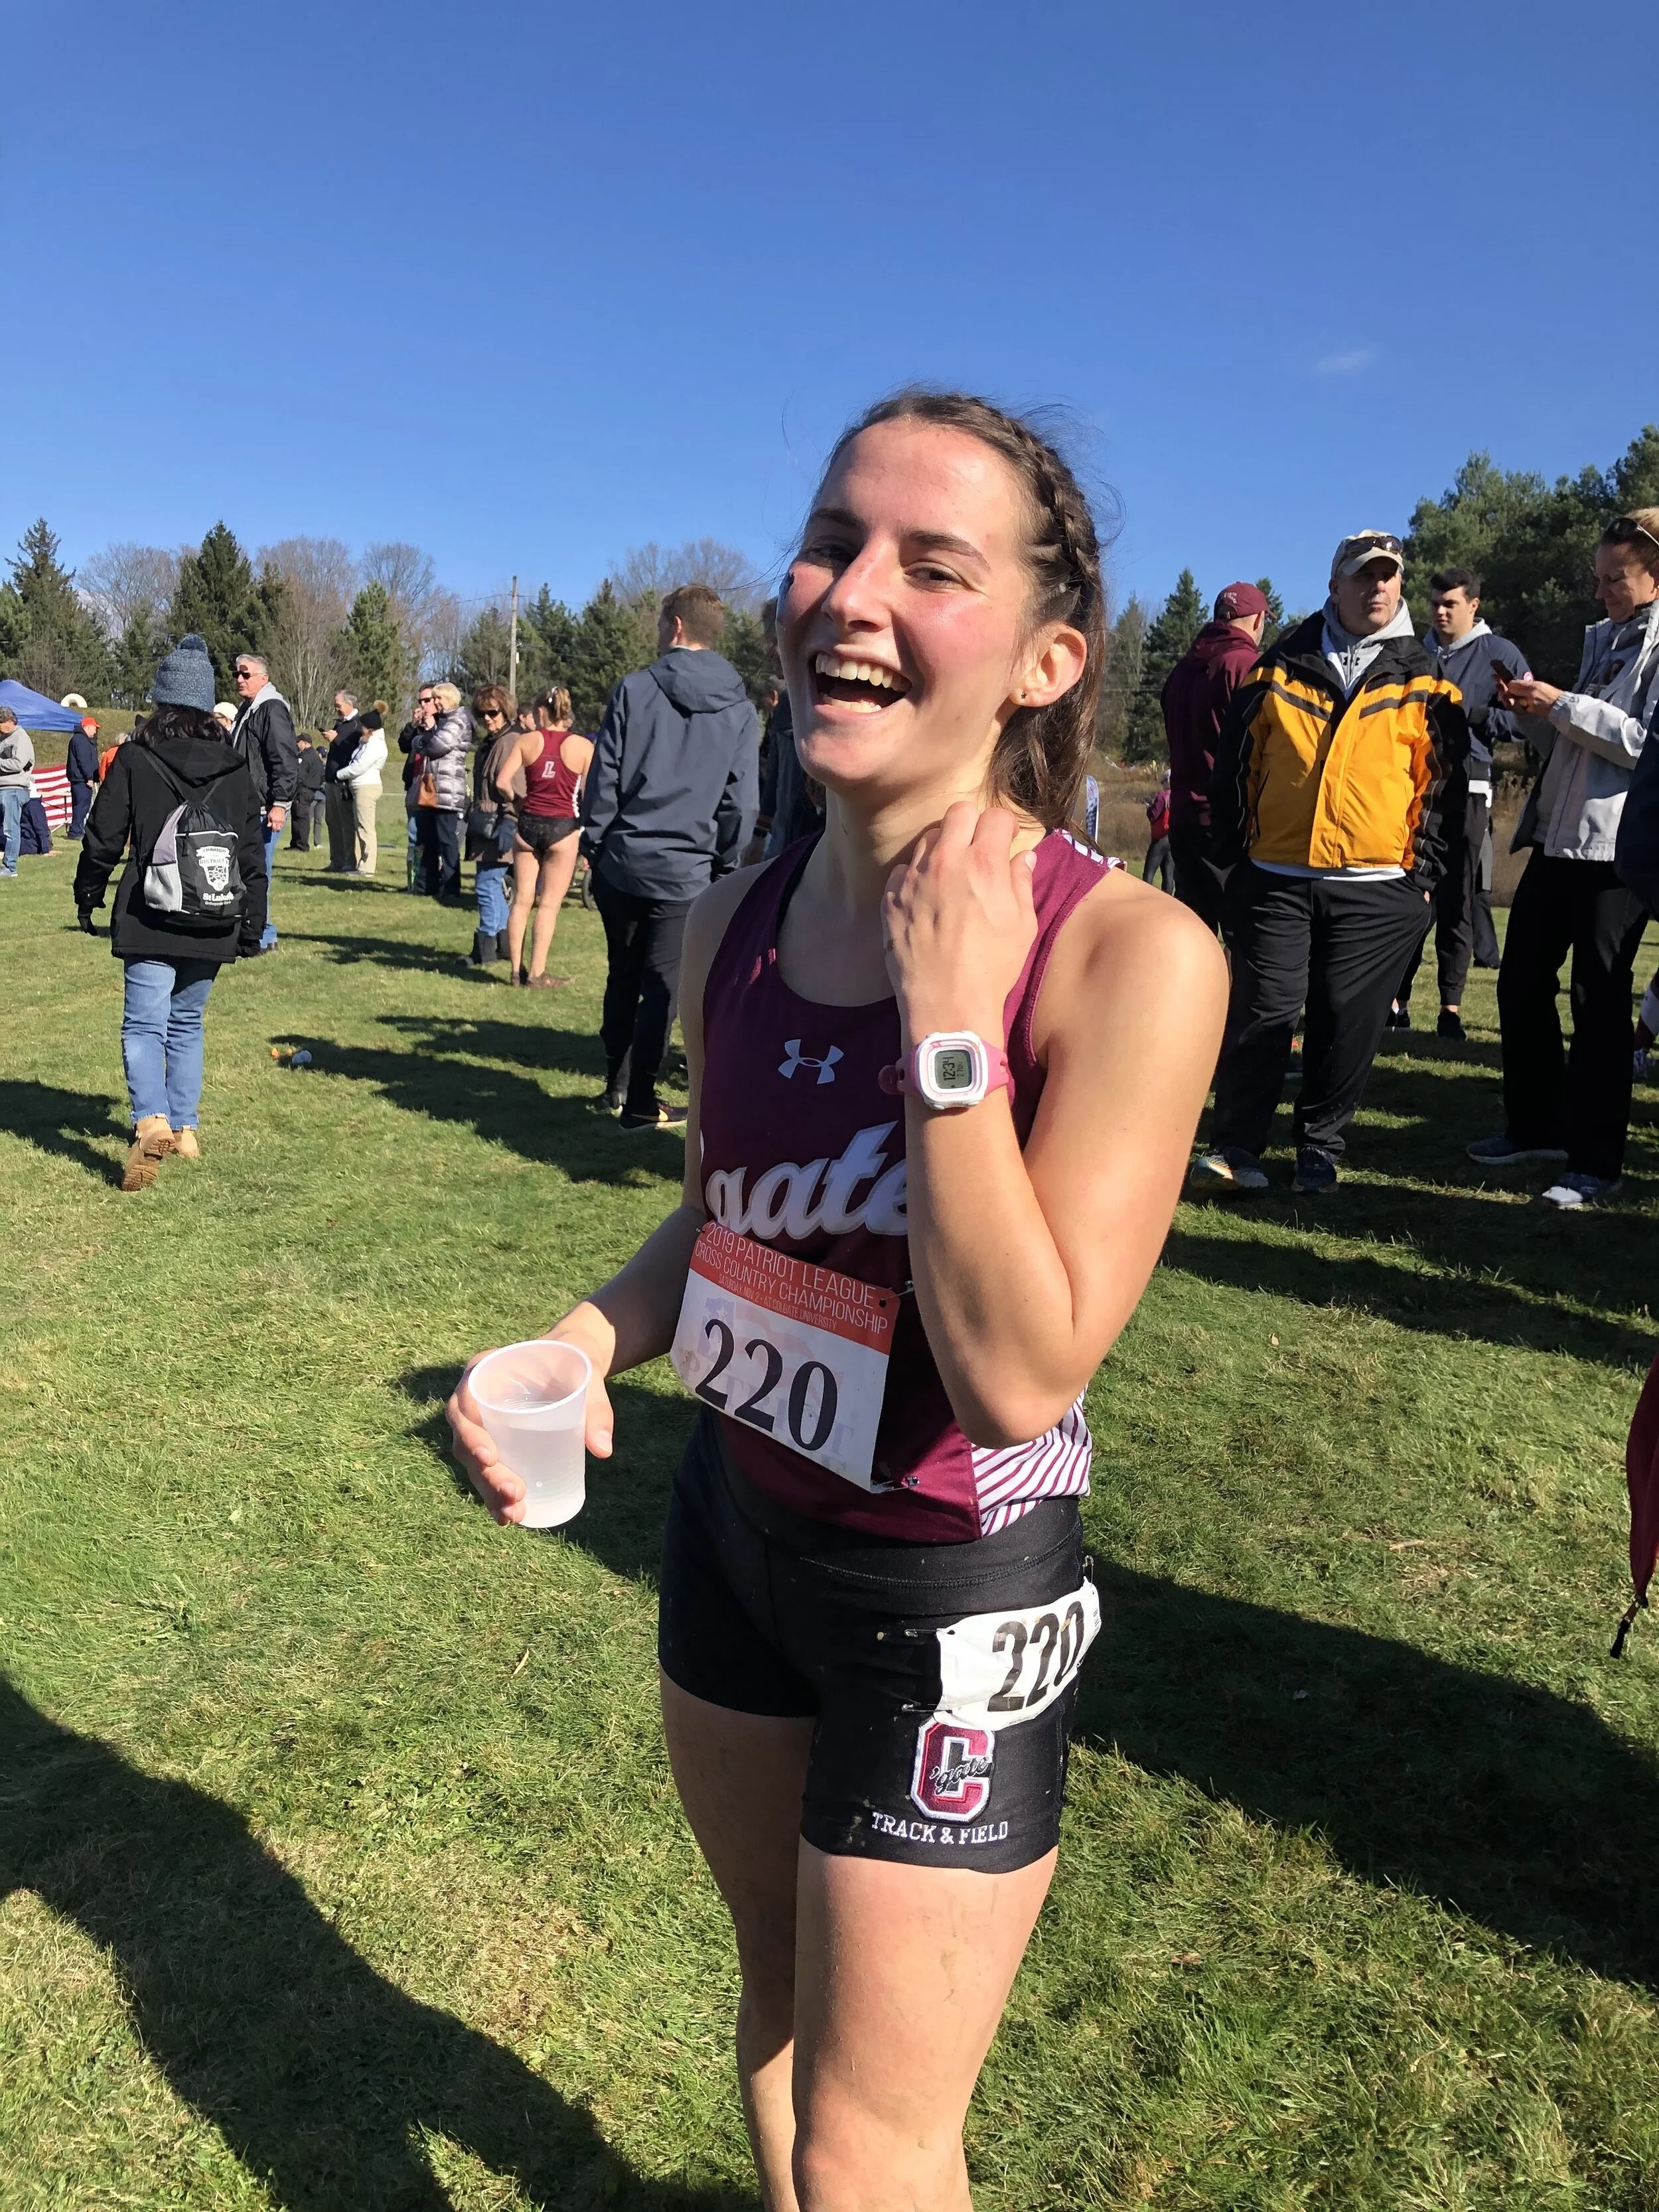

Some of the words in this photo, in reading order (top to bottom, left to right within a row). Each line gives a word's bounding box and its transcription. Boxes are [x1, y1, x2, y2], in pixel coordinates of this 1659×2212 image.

[541, 761, 556, 778] L
[942, 1057, 956, 1081] 12:34
[699, 1120, 908, 1240] gate
[695, 1240, 723, 1269] CROSS
[723, 1257, 776, 1294] COUNTRY
[779, 1282, 888, 1334] CHAMPIONSHIP
[705, 1222, 735, 1253] 2019
[736, 1238, 798, 1281] PATRIOT
[802, 1264, 876, 1309] LEAGUE
[718, 1274, 743, 1293] SATURDAY
[764, 1297, 772, 1307] AT
[772, 1299, 799, 1318] COLGATE
[800, 1310, 837, 1331] UNIVERSITY
[695, 1319, 838, 1451] 220
[987, 1601, 1084, 1712] 220
[910, 1718, 995, 1821] C
[871, 1811, 935, 1844] TRACK
[940, 1825, 956, 1844] &
[958, 1821, 1009, 1844] FIELD
